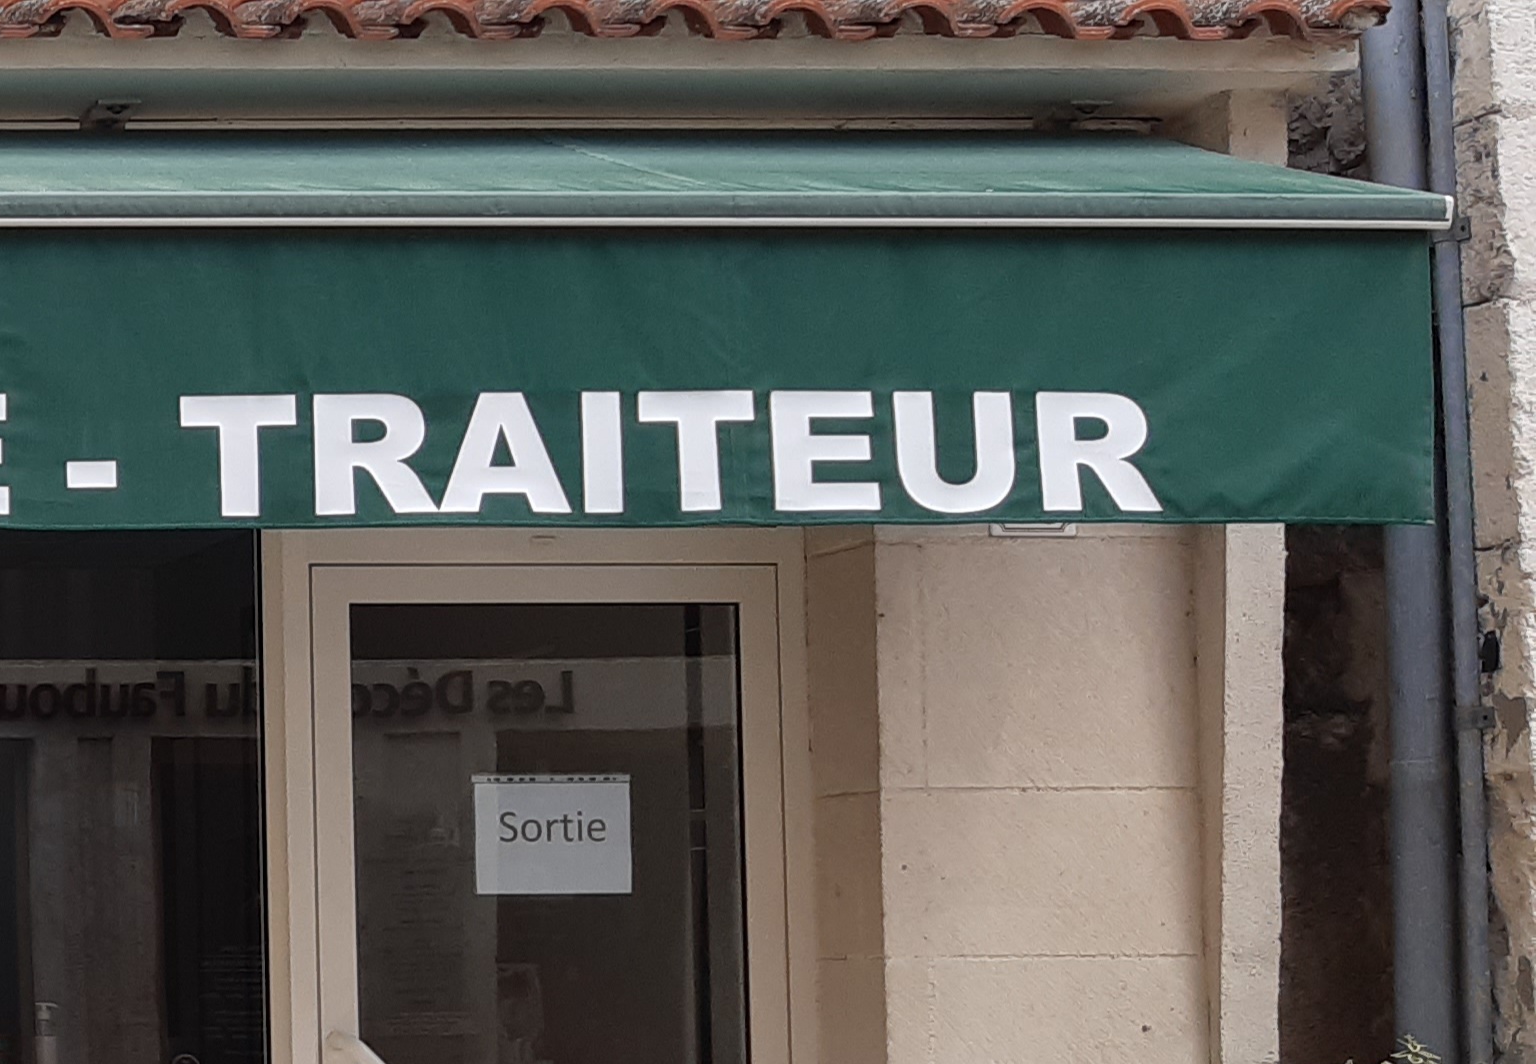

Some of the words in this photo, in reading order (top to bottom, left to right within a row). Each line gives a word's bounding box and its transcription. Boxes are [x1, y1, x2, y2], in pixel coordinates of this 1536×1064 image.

[67, 461, 117, 489] -
[179, 390, 1164, 517] TRAITEUR
[499, 811, 606, 842] Sortie
